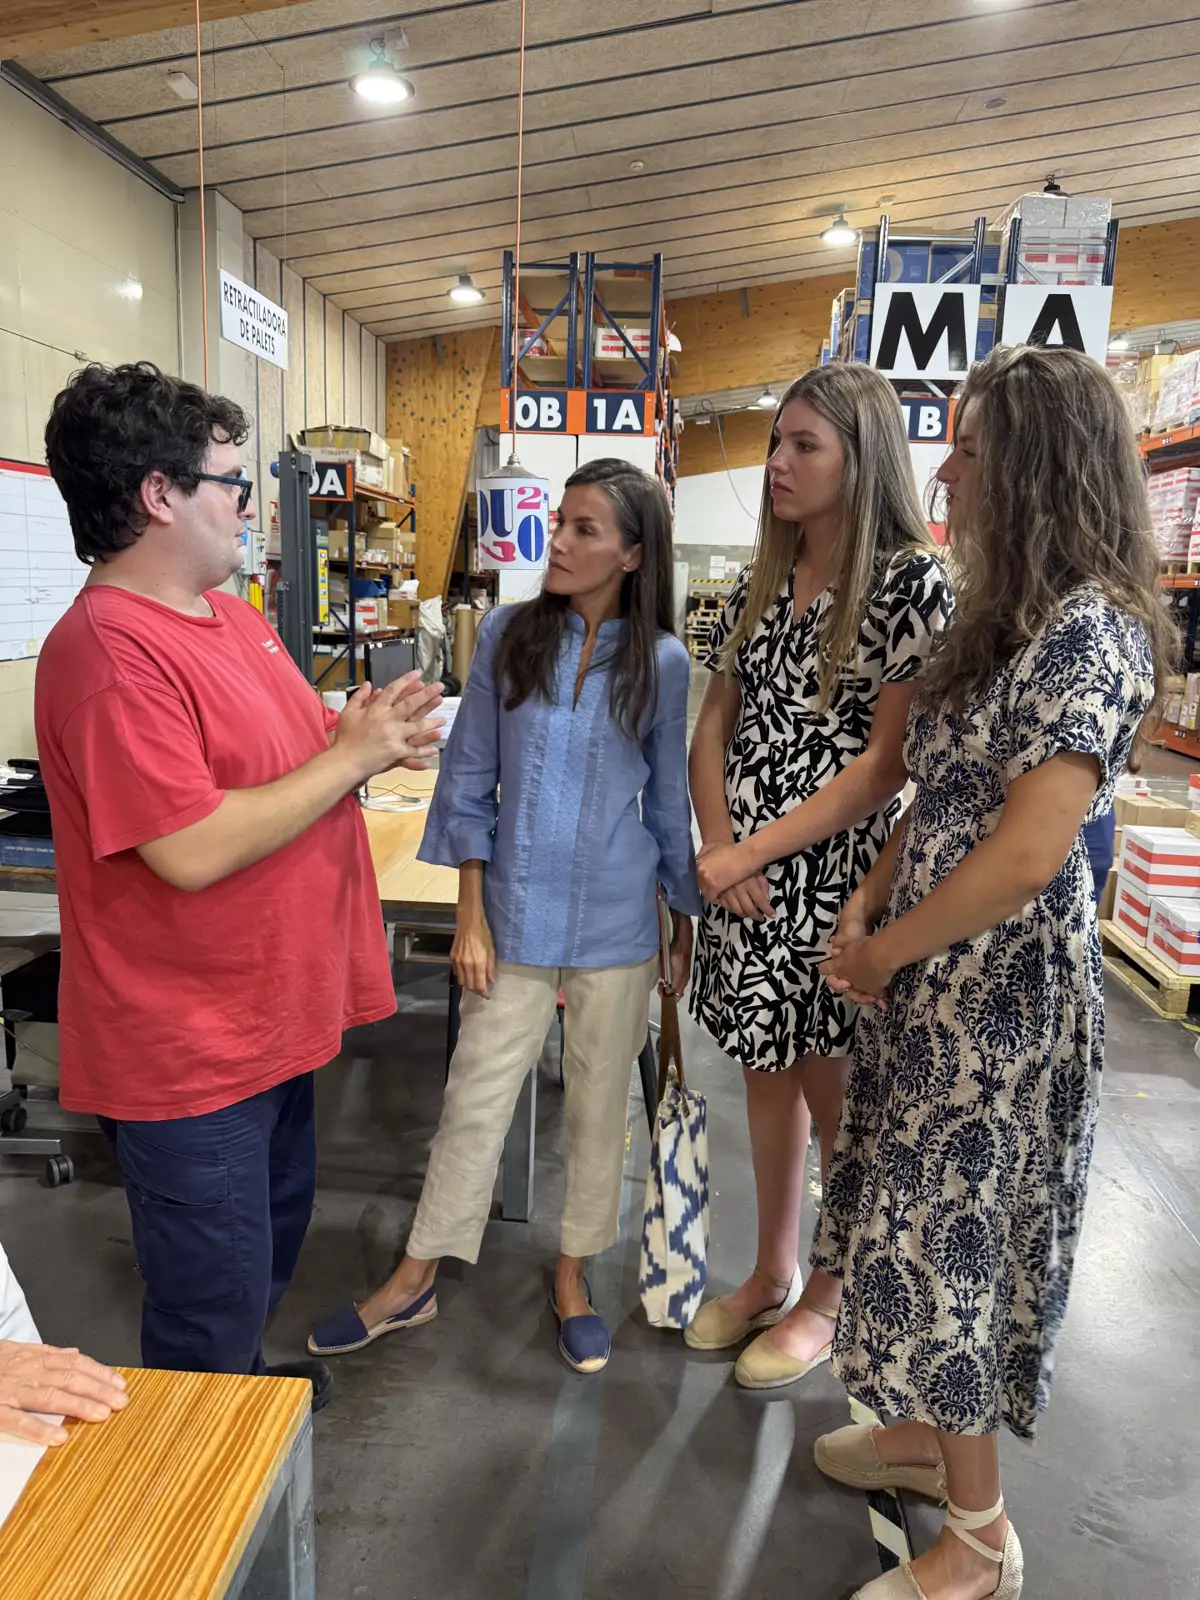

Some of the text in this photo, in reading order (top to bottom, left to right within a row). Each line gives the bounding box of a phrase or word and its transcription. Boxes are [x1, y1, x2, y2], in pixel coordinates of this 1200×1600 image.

[223, 281, 286, 338] RETRACTILADORA
[240, 318, 275, 355] DE PALETS
[876, 292, 968, 371] M
[1026, 294, 1086, 354] A
[593, 399, 642, 430] 1A
